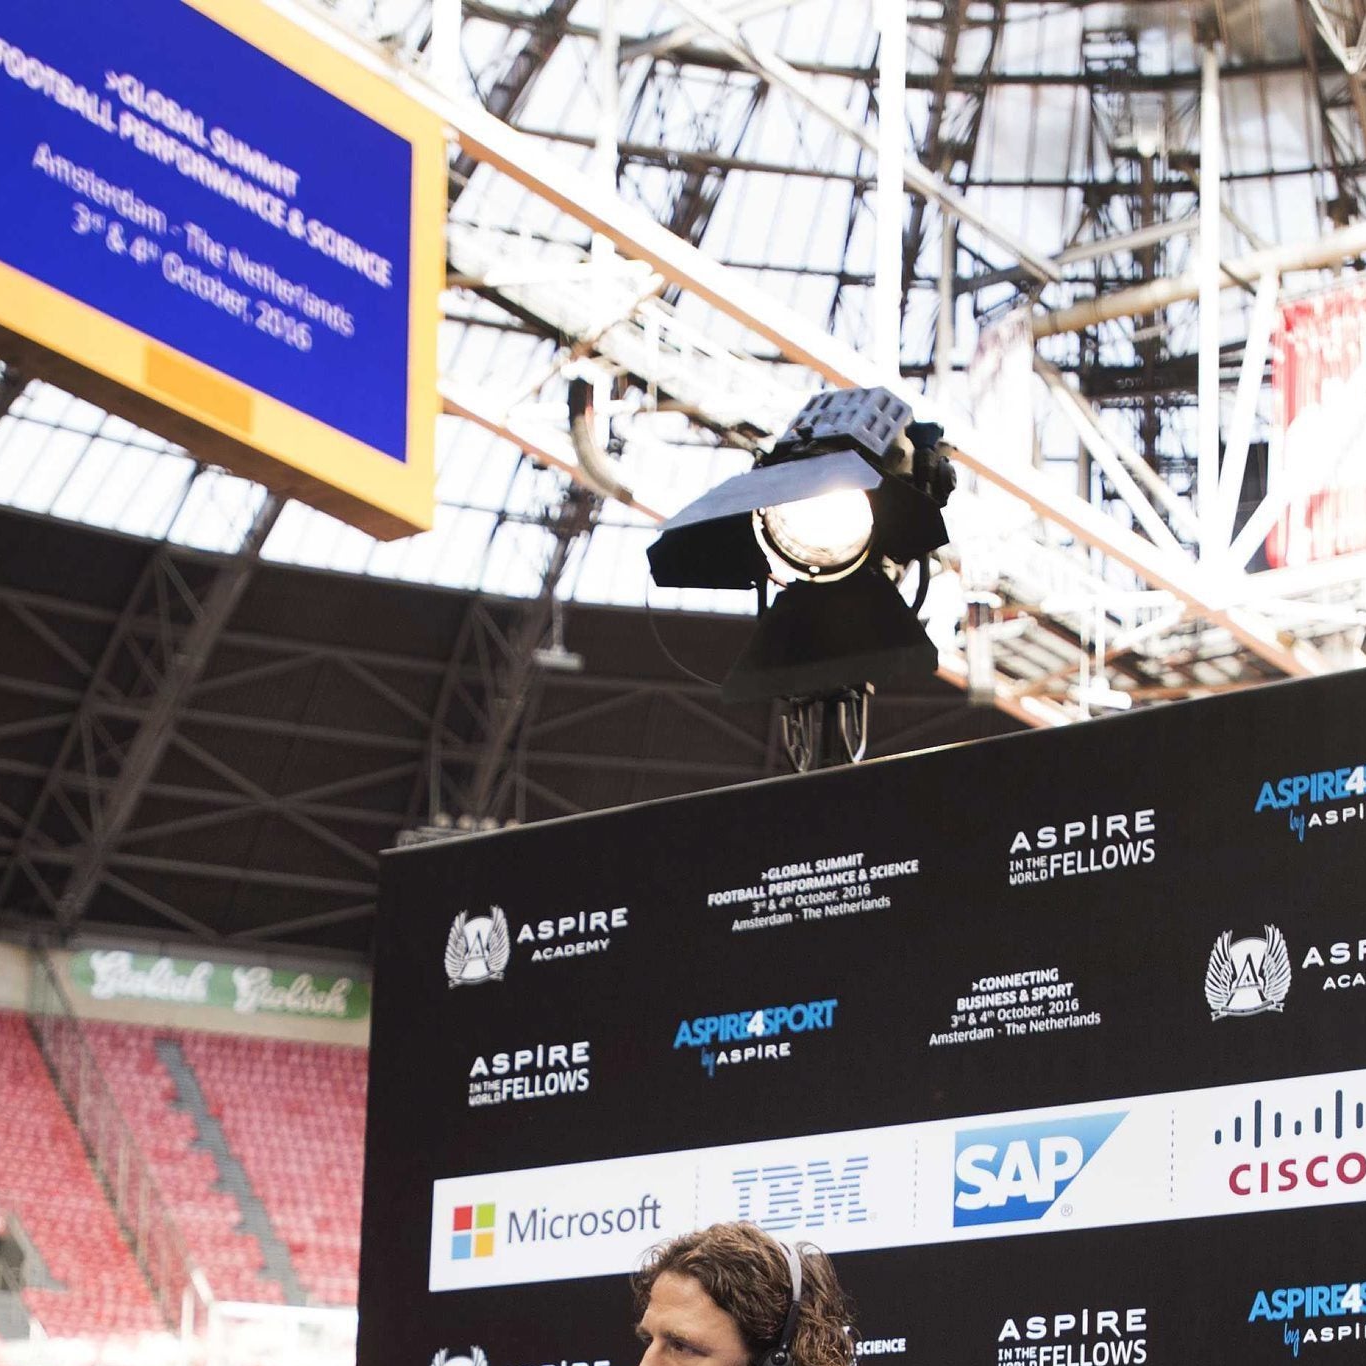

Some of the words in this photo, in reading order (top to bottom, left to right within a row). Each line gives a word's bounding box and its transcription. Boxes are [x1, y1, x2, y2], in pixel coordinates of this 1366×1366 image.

[210, 127, 300, 198] SUMMIT
[119, 110, 287, 230] PERFORMANCE
[287, 208, 306, 240] &
[306, 219, 393, 290] SCIENCE
[32, 143, 167, 234] Amsterdam
[184, 222, 227, 270] The
[228, 247, 355, 338] Netherlands
[105, 222, 127, 255] &
[255, 301, 313, 353] 2016
[1009, 808, 1156, 854] ASPIRE
[1290, 809, 1306, 843] by
[1009, 859, 1024, 873] IN
[1025, 855, 1048, 870] THE
[1009, 868, 1049, 886] WORLD
[1049, 839, 1156, 878] FELLOWS
[516, 907, 628, 944] ASPIRE
[531, 938, 610, 961] ACADEMY
[673, 999, 838, 1048] ASPIRE4SPORT
[469, 1041, 590, 1078] ASPIRE
[702, 1046, 715, 1079] by
[716, 1042, 791, 1065] ASPIRE
[500, 1067, 590, 1101] FELLOWS
[956, 1135, 1084, 1210] SAP
[732, 1156, 869, 1230] IBM
[507, 1194, 662, 1244] Microsoft
[1284, 1322, 1300, 1358] by
